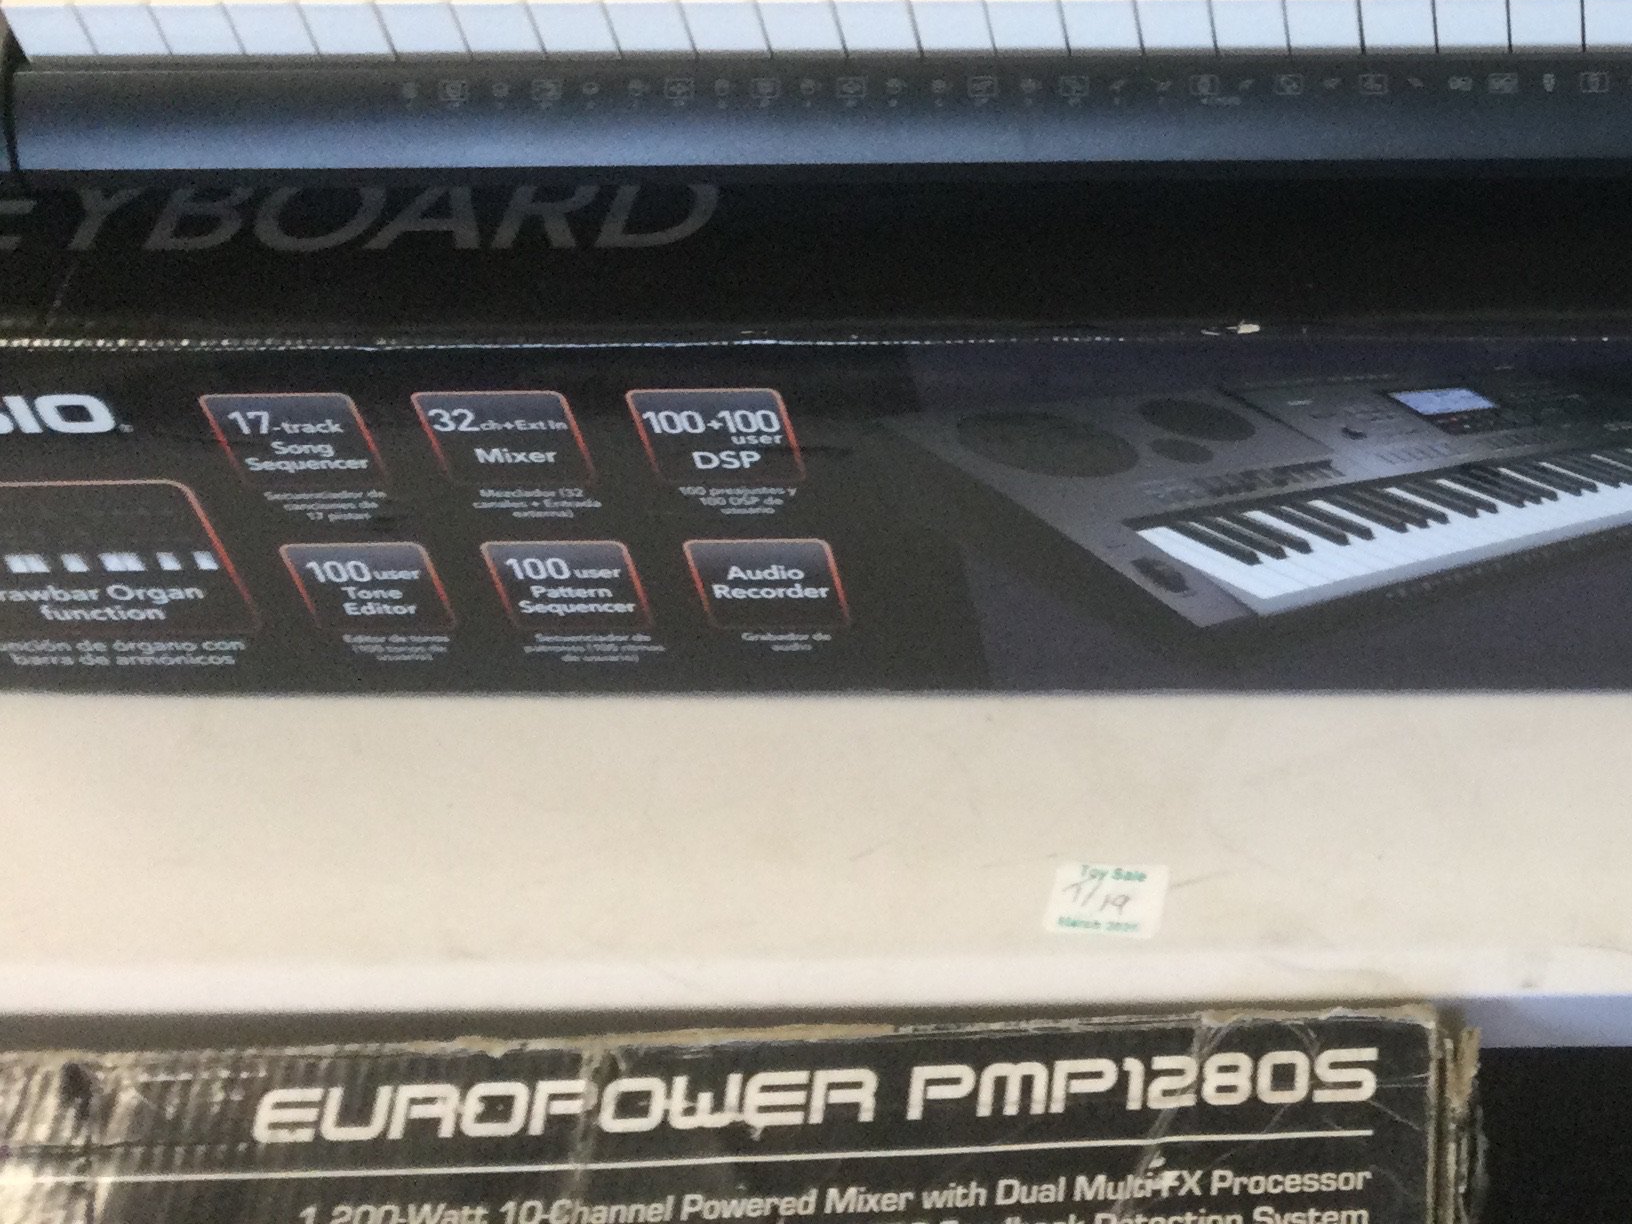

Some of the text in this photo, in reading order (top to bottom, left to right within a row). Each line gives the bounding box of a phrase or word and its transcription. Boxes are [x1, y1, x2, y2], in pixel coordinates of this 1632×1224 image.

[227, 410, 345, 436] 17-track
[730, 433, 782, 446] user
[271, 440, 336, 458] Song
[473, 447, 557, 464] Mixer
[245, 457, 369, 474] Sequencer
[691, 450, 761, 471] DSP
[305, 560, 420, 584] 100 user
[505, 557, 621, 581] 100 user
[726, 565, 805, 582] Audio
[106, 583, 205, 605] Organ
[341, 586, 403, 600] Tone
[530, 585, 613, 599] Pattern
[712, 583, 830, 600] Recorder
[39, 603, 168, 621] function
[342, 602, 417, 616] Editor
[518, 599, 636, 618] Sequencer
[201, 640, 246, 652] con
[252, 1046, 1379, 1145] EUROPOWER PMP1280S
[498, 1193, 674, 1224] 10-Channel
[680, 1189, 818, 1220] Powered
[824, 1185, 914, 1215] Mixer
[921, 1180, 988, 1210] with
[994, 1177, 1066, 1206] Dual
[1209, 1168, 1373, 1197] Processor
